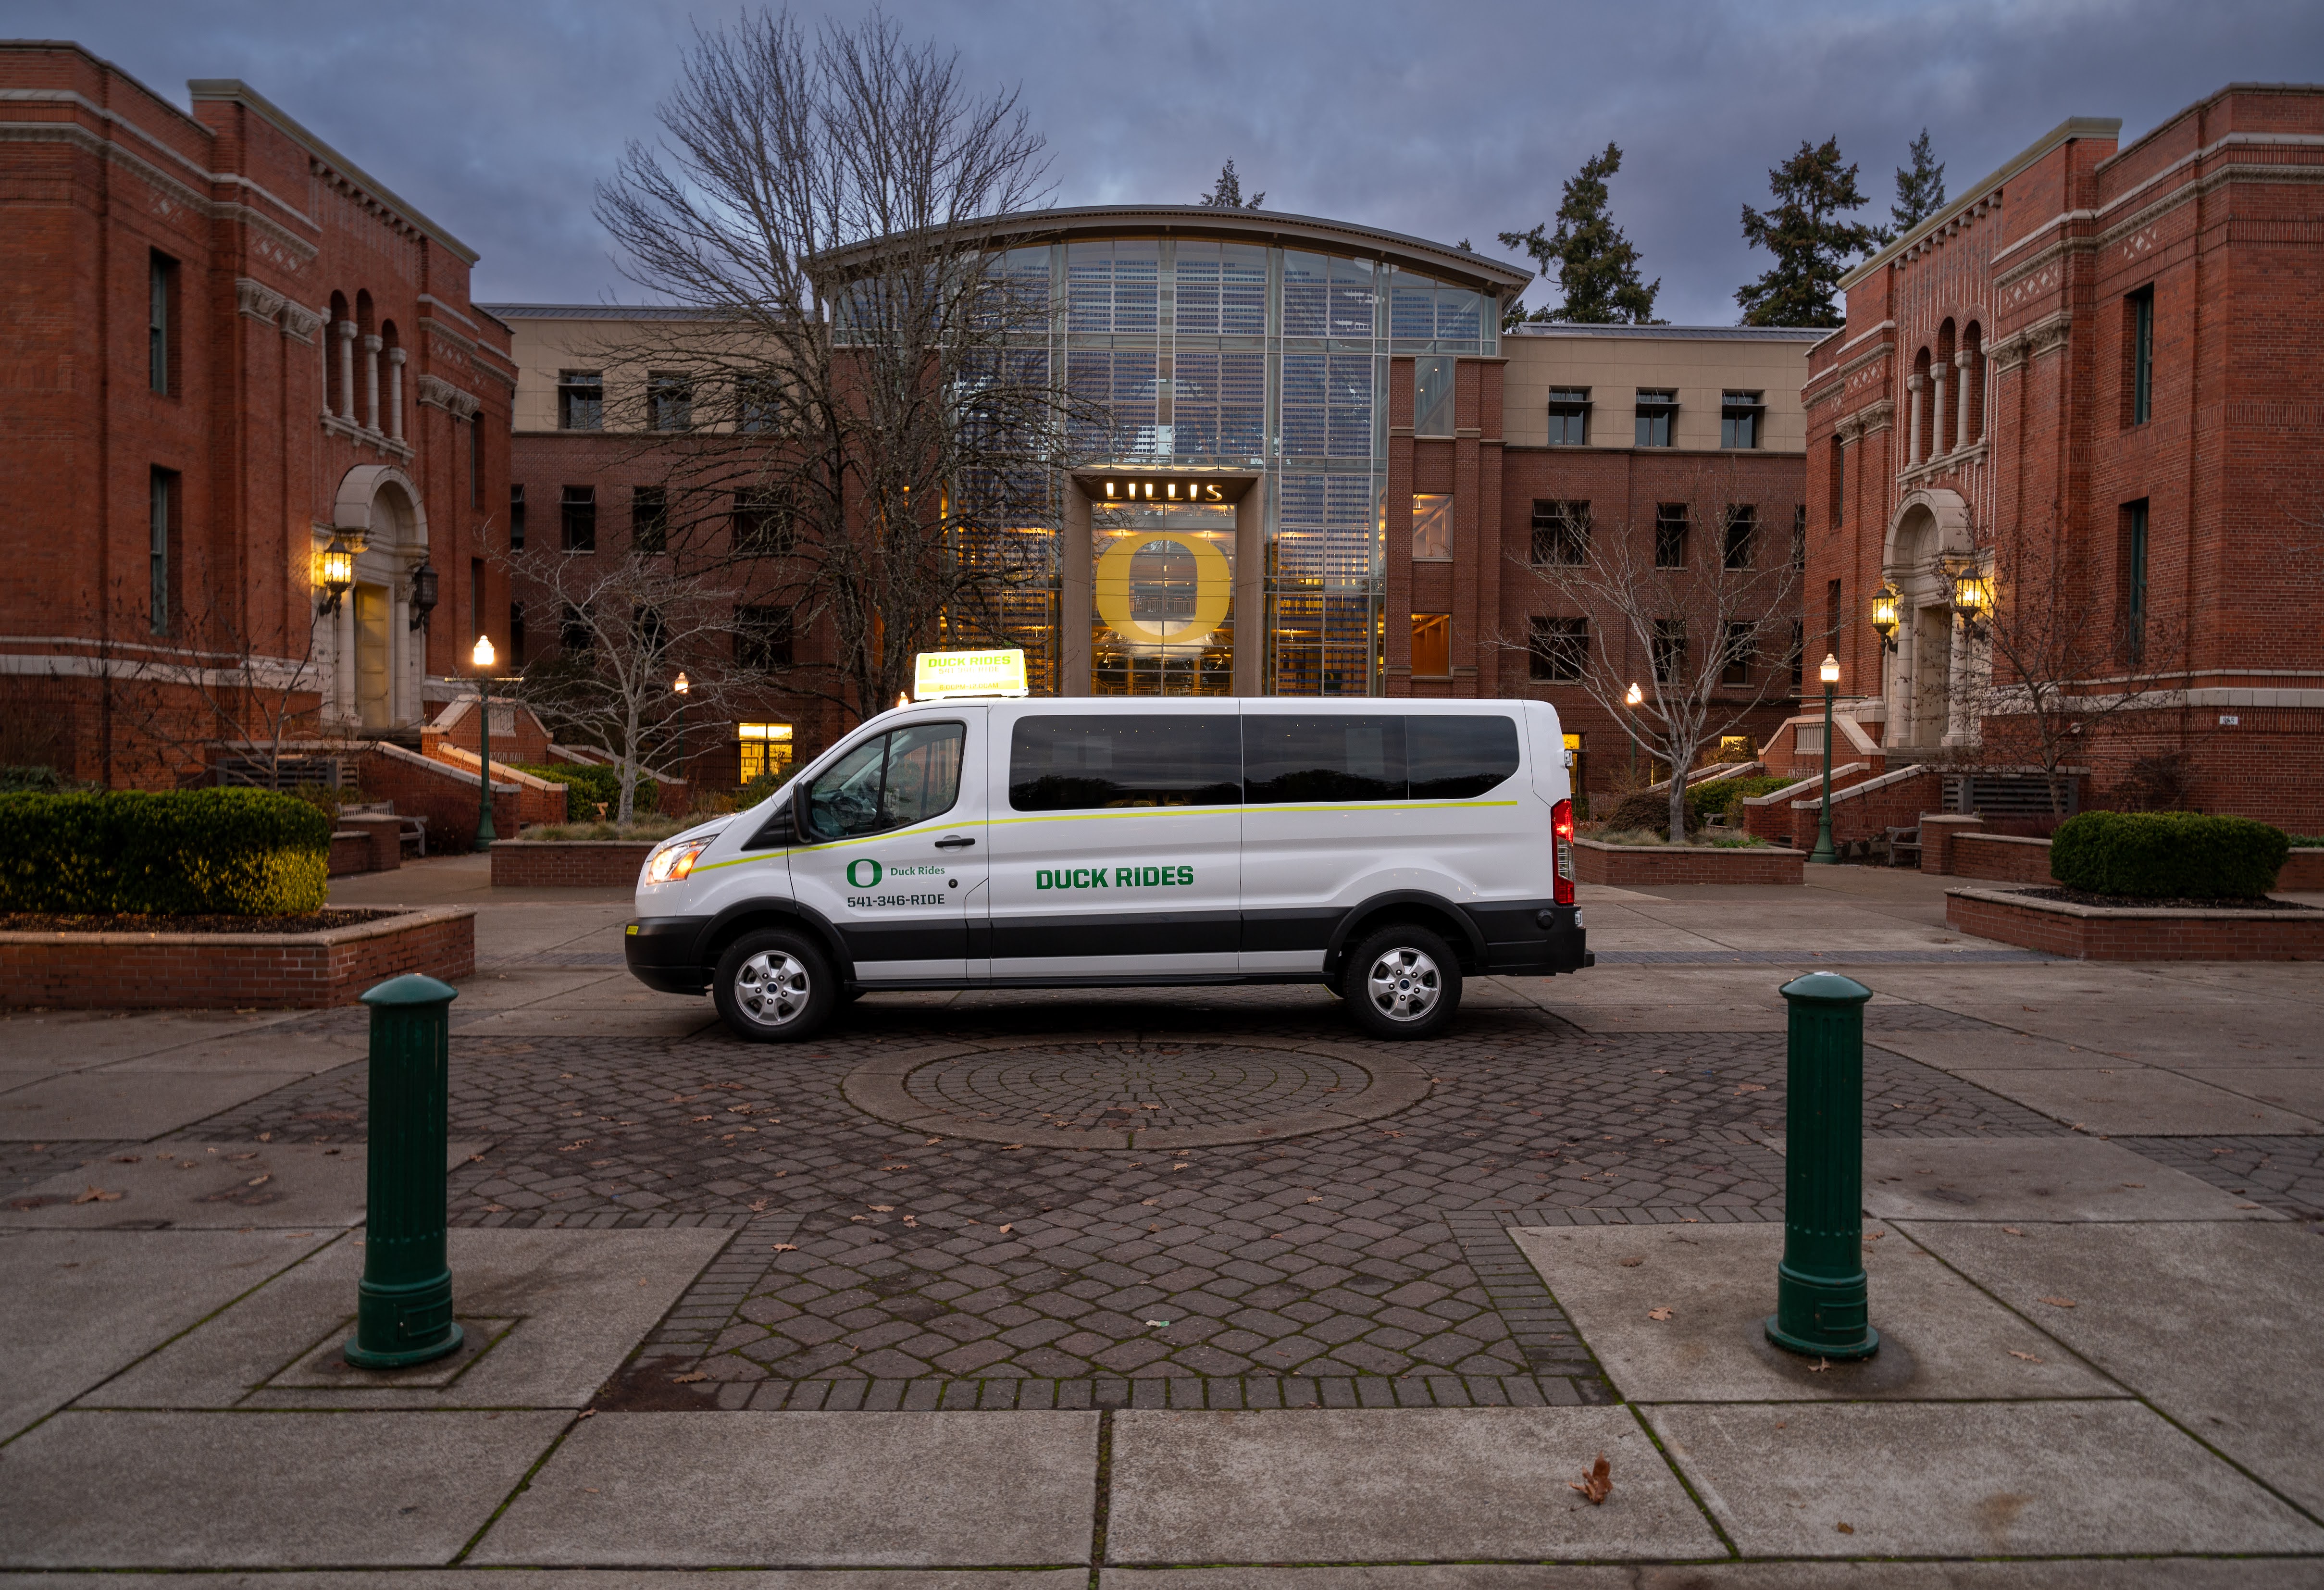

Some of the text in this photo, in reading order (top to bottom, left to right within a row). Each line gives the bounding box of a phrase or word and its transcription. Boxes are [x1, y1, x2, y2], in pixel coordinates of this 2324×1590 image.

[1106, 483, 1222, 502] LILLIS
[1096, 532, 1230, 644] O
[928, 656, 1011, 667] DUCK RIDES
[1788, 769, 1814, 779] ANSTETT
[846, 858, 882, 888] O
[891, 866, 945, 876] Duck Rides
[1036, 866, 1193, 890] DUCK RIDES
[847, 894, 945, 907] 541-346-RIDE
